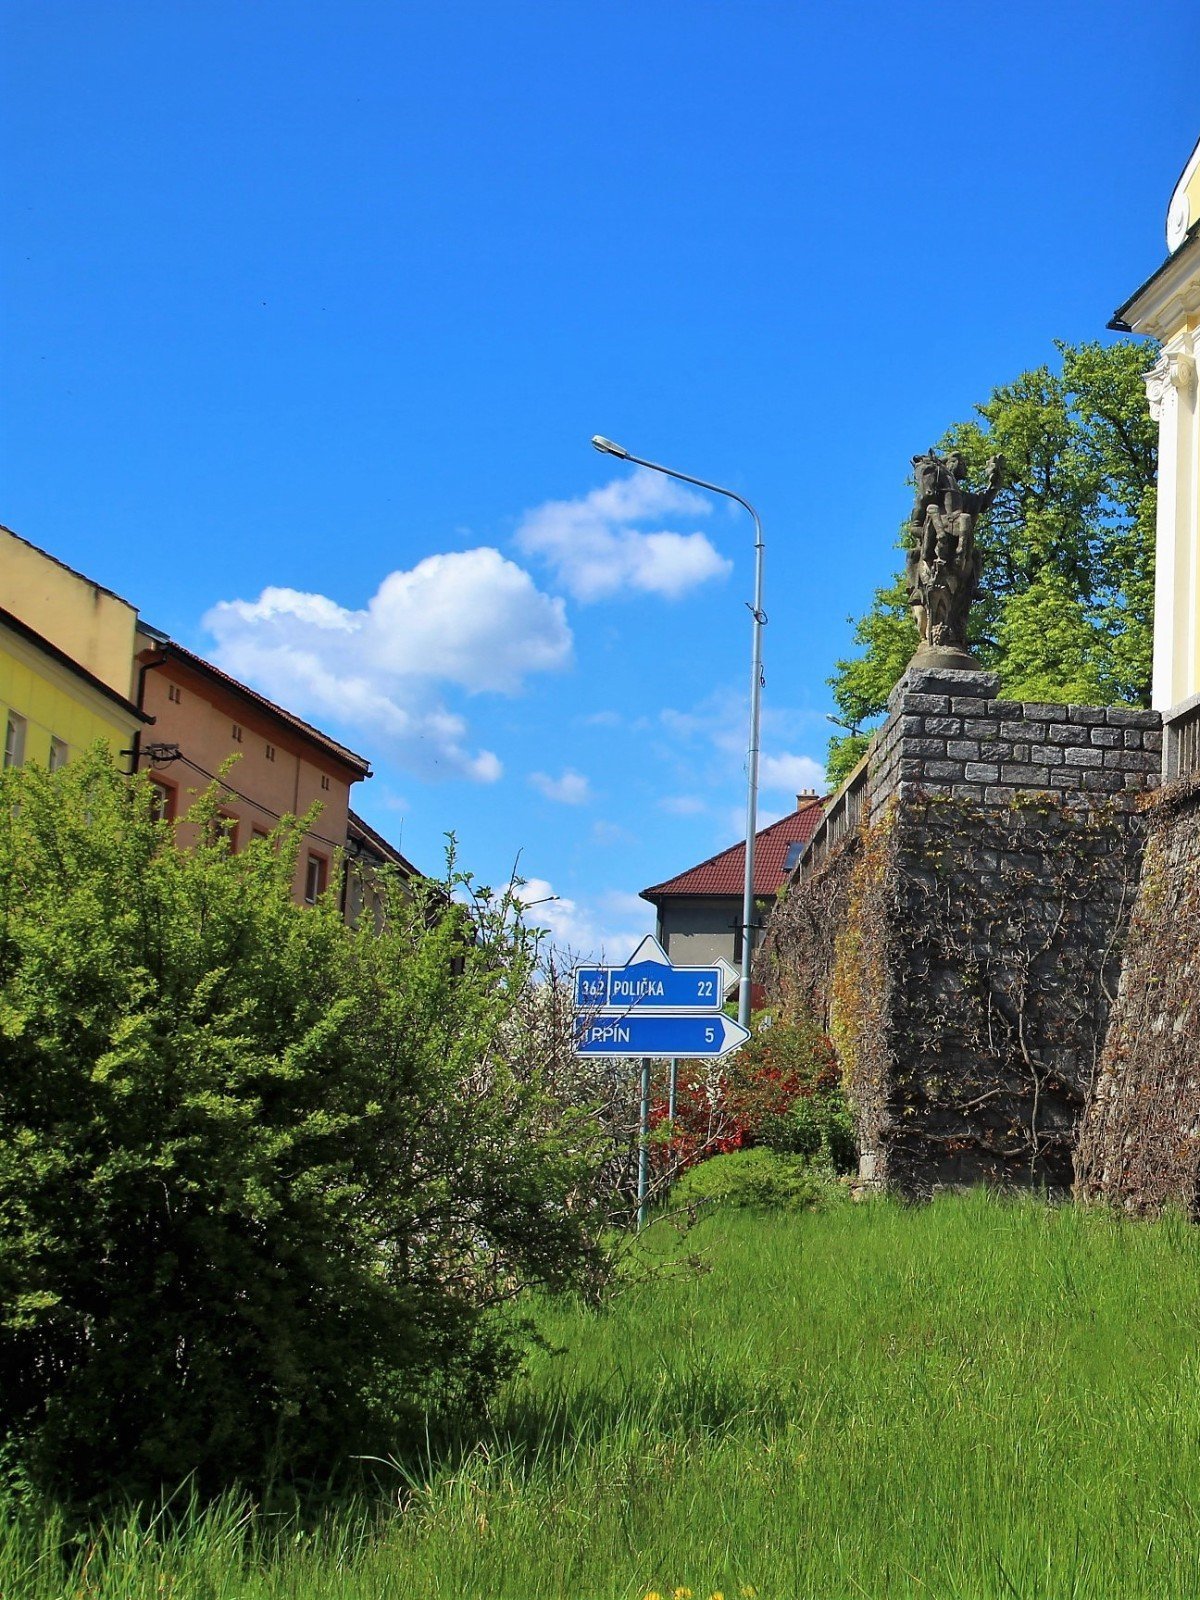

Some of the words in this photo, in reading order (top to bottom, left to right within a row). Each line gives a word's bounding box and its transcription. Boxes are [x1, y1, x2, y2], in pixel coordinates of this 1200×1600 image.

[581, 980, 605, 996] 362
[613, 977, 665, 996] POLIČKA
[697, 981, 713, 996] 22
[704, 1027, 715, 1043] 5
